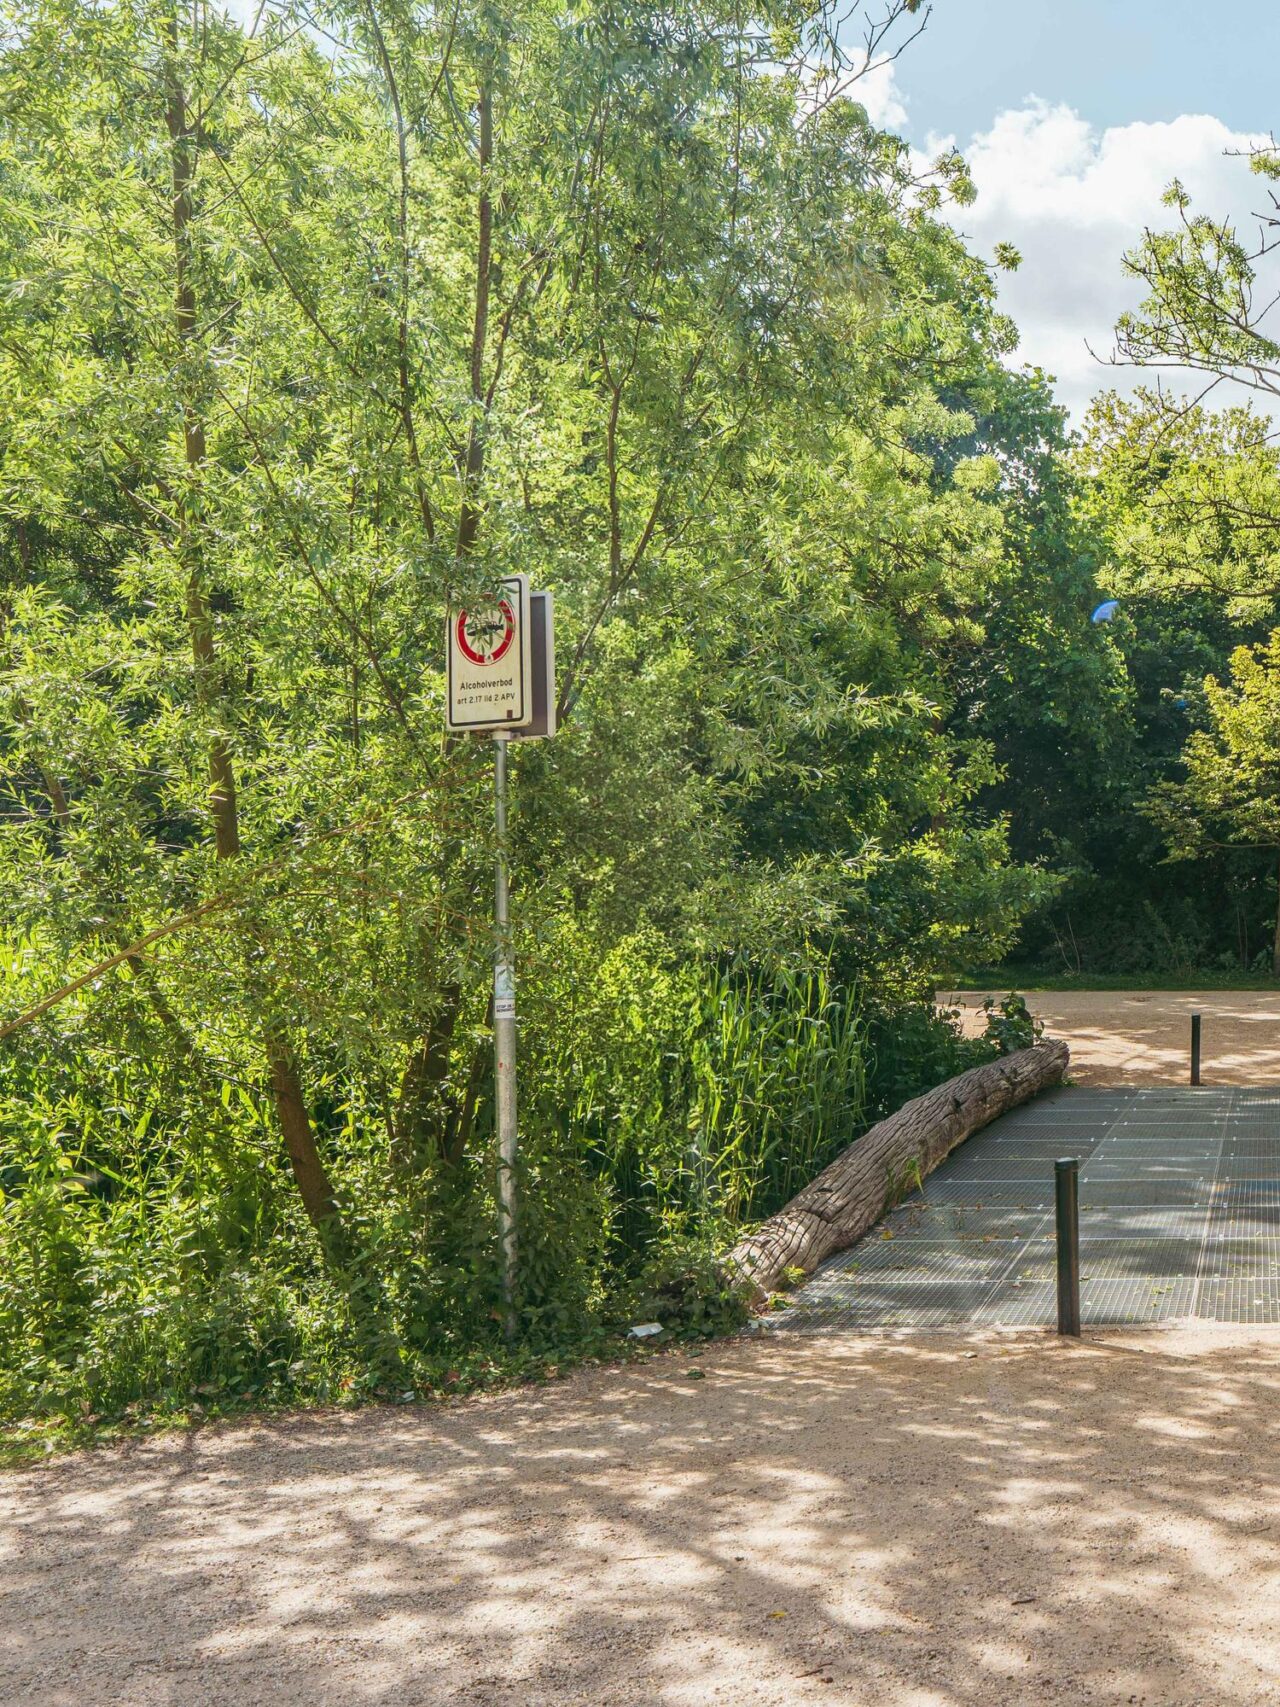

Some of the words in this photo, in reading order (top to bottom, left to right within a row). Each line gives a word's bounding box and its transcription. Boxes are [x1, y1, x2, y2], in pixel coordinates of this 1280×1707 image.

[460, 677, 513, 691] Alcoholverbod
[457, 697, 467, 705] art
[469, 695, 482, 704] 2.17
[501, 692, 515, 701] APV
